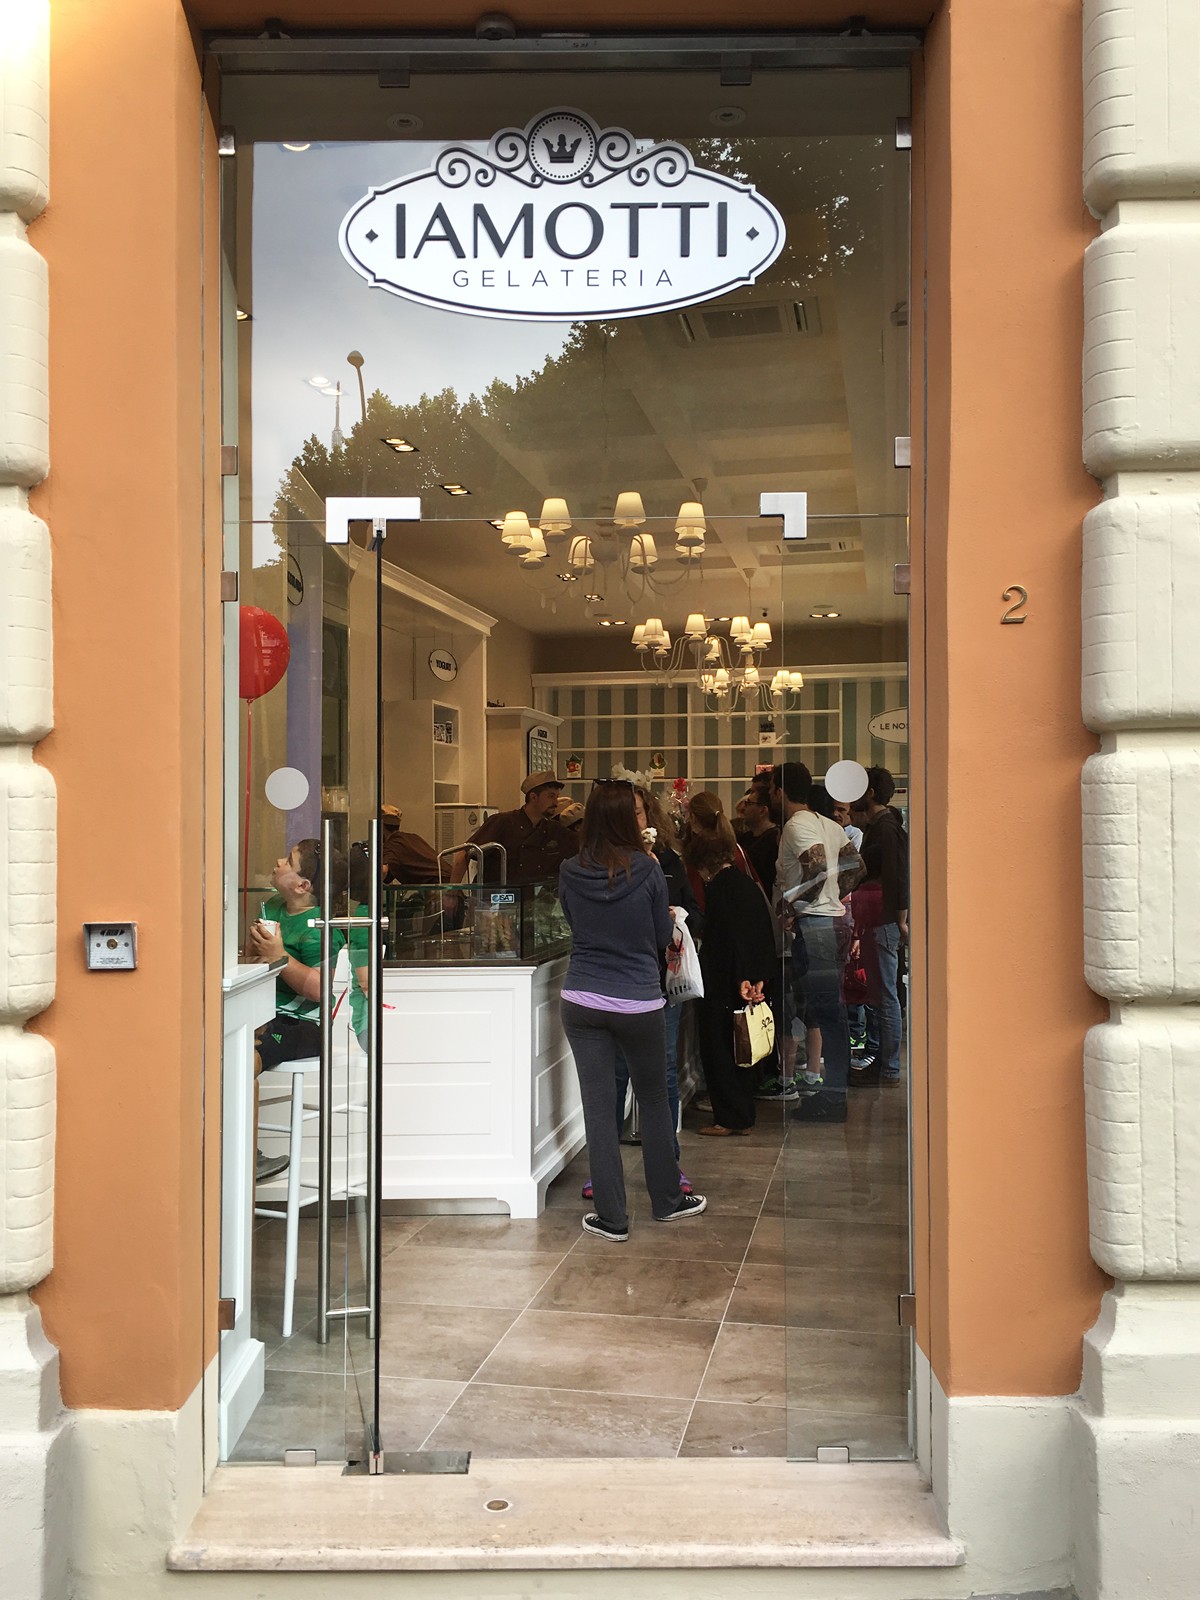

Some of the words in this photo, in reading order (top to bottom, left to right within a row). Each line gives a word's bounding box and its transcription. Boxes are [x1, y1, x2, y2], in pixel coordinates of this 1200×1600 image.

[396, 201, 728, 259] IAMOTTI
[453, 269, 673, 288] GELATERIA
[1001, 584, 1028, 625] 2
[892, 722, 908, 730] NO
